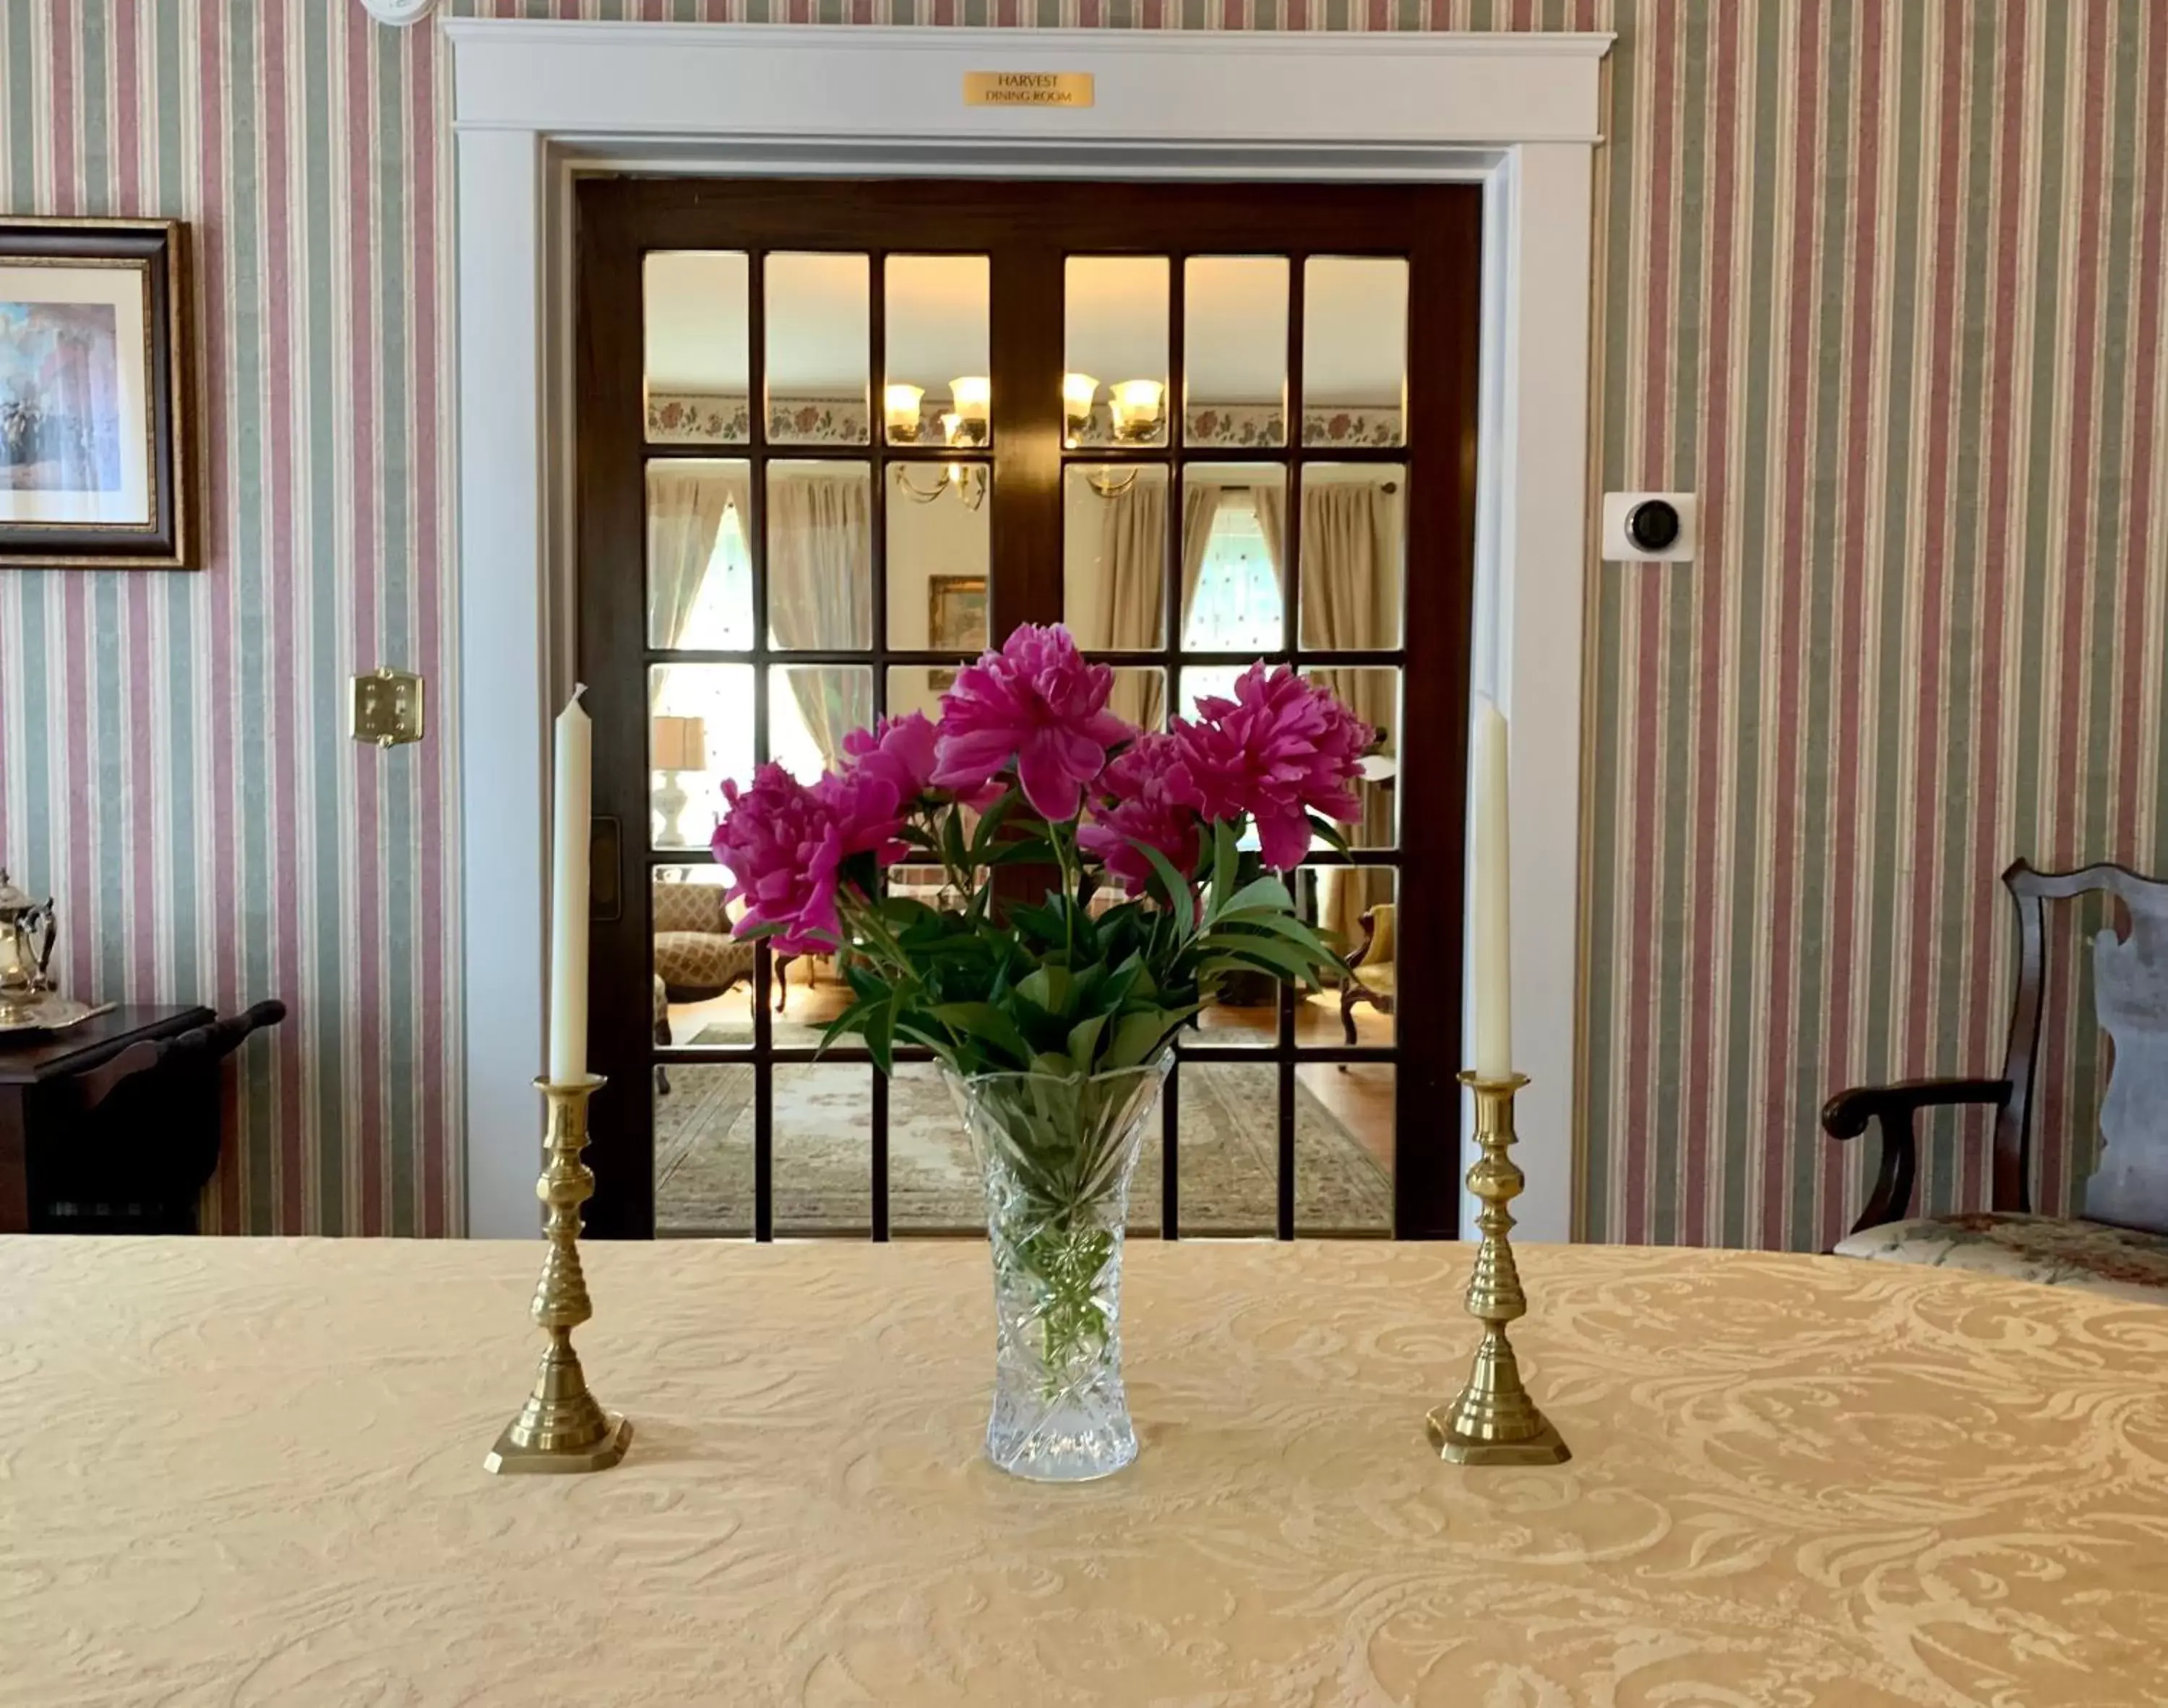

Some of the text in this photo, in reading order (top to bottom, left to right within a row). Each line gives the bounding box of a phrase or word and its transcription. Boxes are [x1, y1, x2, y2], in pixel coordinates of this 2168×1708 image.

[998, 74, 1059, 87] HARVEST
[986, 90, 1072, 102] DINING ROOM
